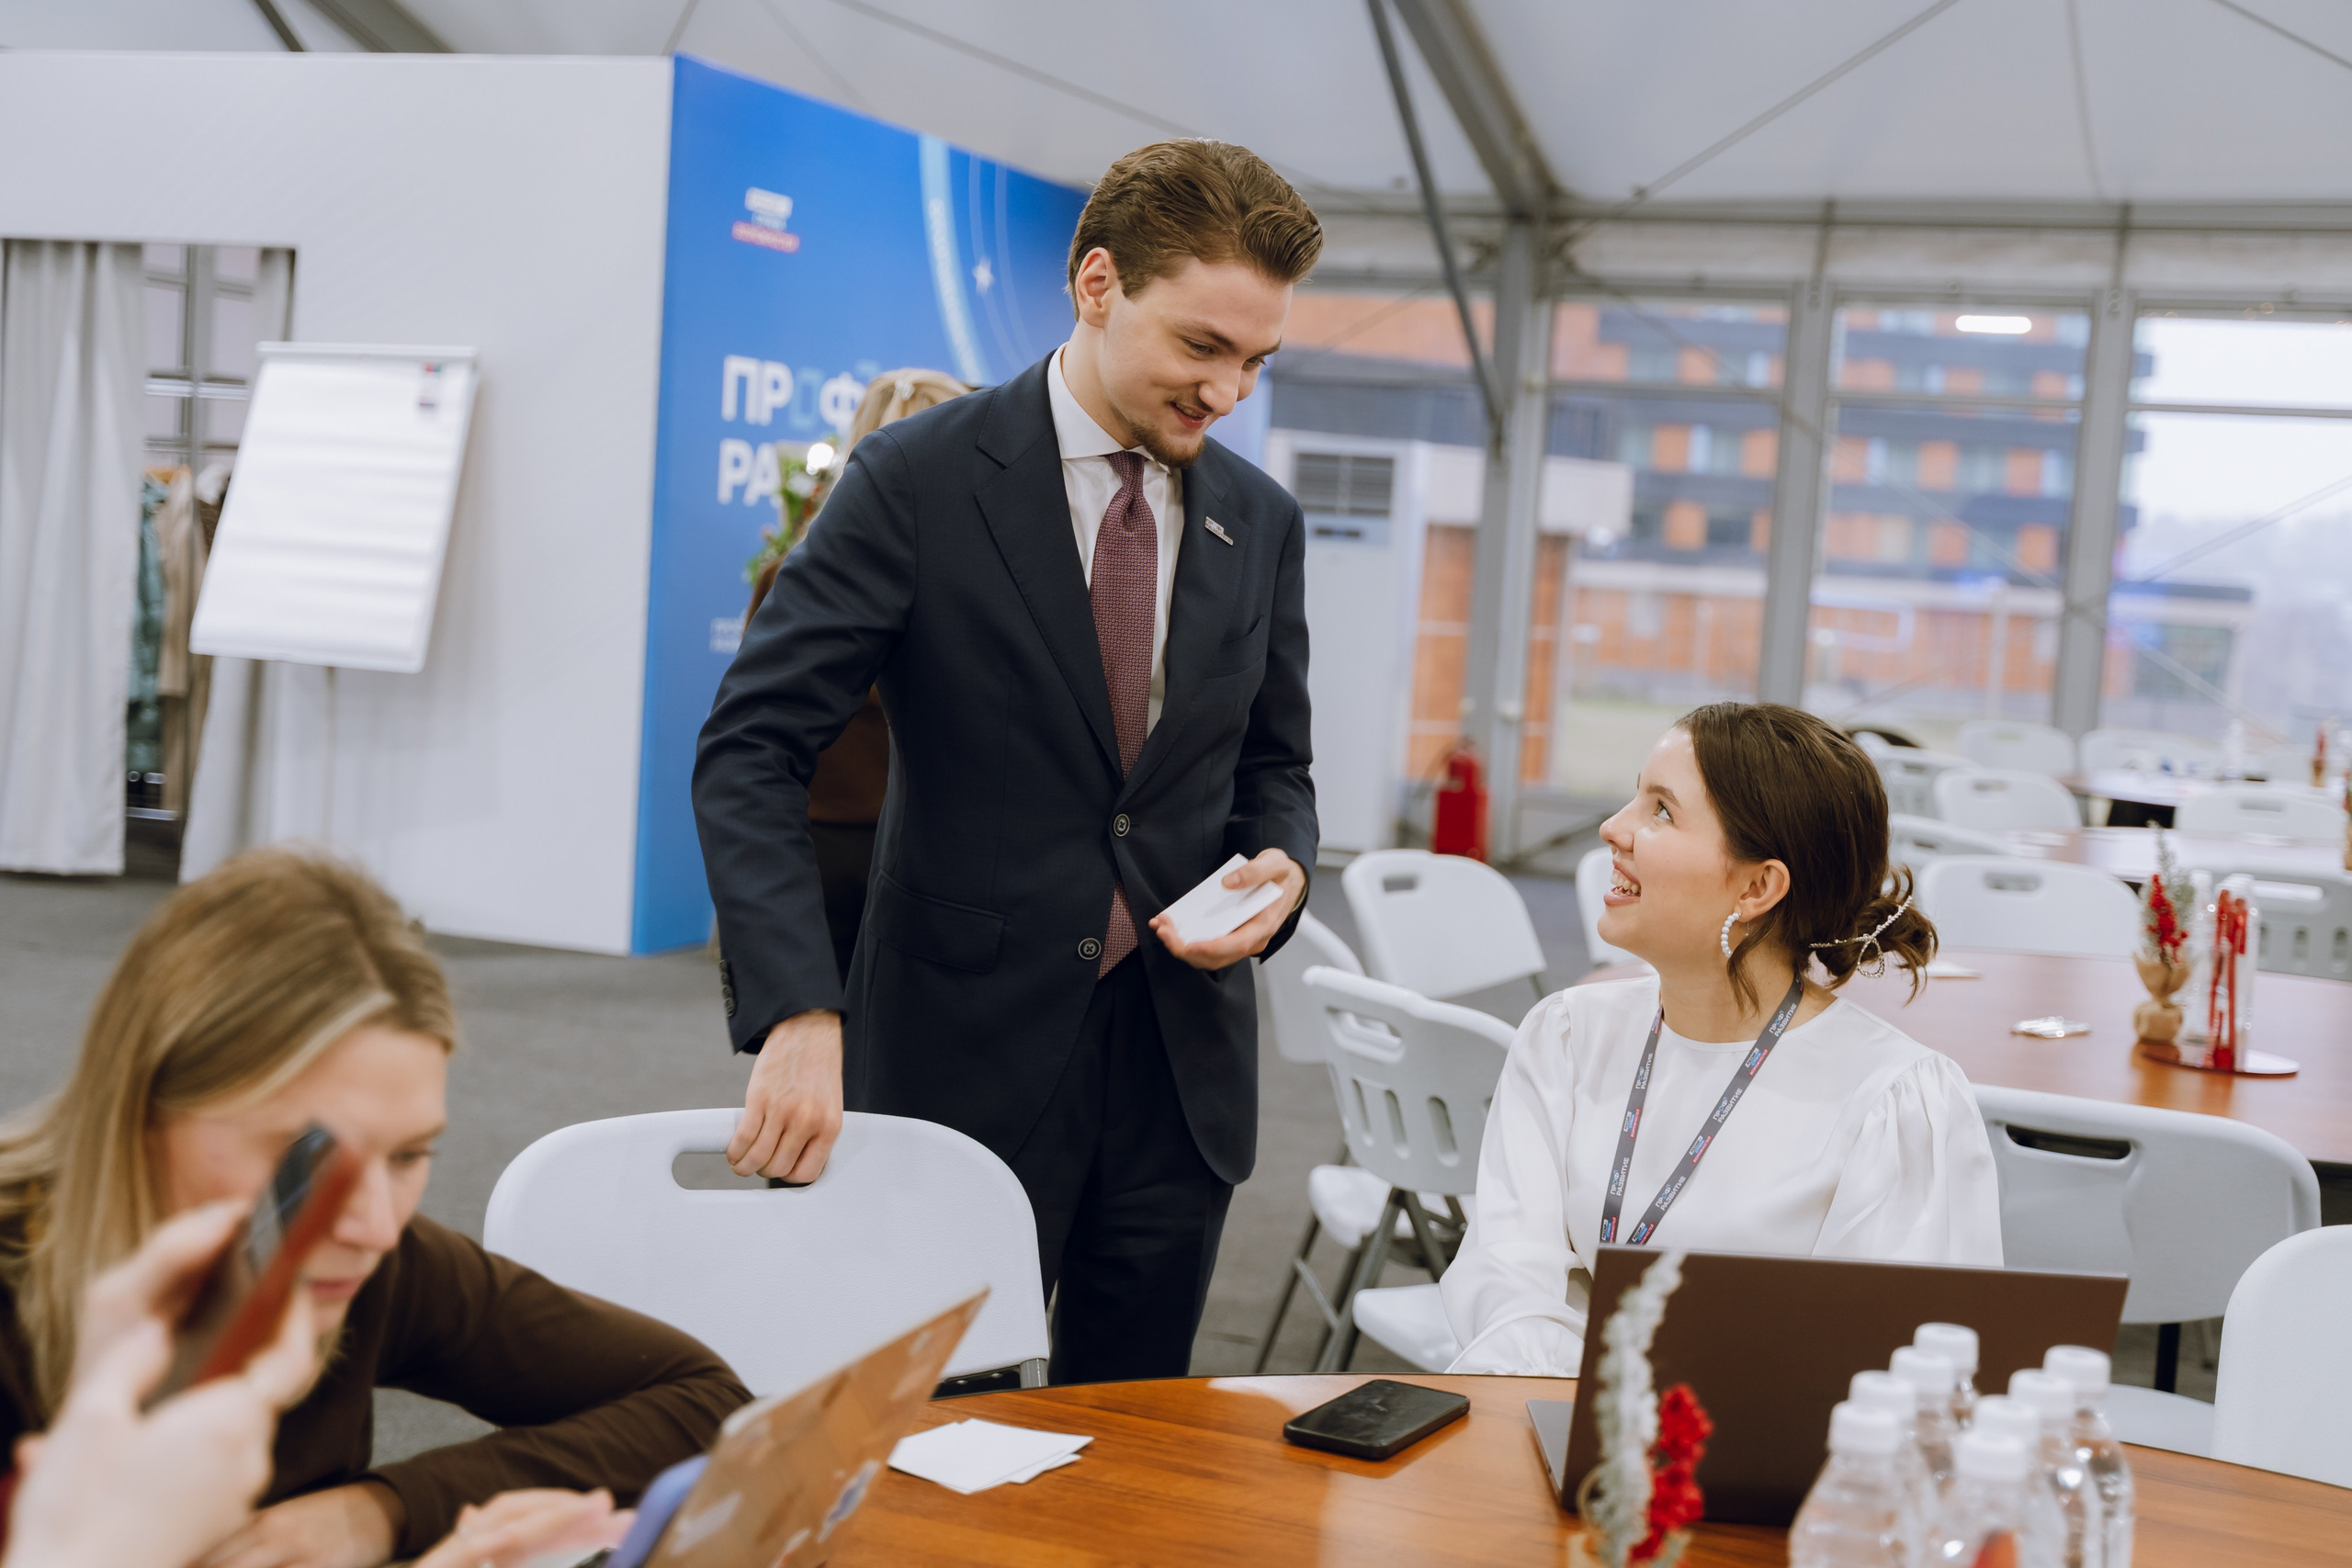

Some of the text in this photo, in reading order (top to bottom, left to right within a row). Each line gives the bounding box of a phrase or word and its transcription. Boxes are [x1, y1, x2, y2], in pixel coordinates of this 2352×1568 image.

[1769, 1012, 1784, 1033] ПРОФ
[1774, 1002, 1797, 1037] РАЗВИТИЕ
[1635, 1068, 1644, 1089] ПРОФ
[1641, 1053, 1653, 1089] РАЗВИТИЕ
[1713, 1100, 1728, 1121] ПРОФ
[1717, 1088, 1743, 1123] РАЗВИТИЕ
[1611, 1172, 1620, 1195] ПРОФ
[1617, 1157, 1630, 1196] РАЗВИТИЕ
[1655, 1187, 1670, 1208] ПРОФ
[1660, 1176, 1687, 1211] РАЗВИТИЕ
